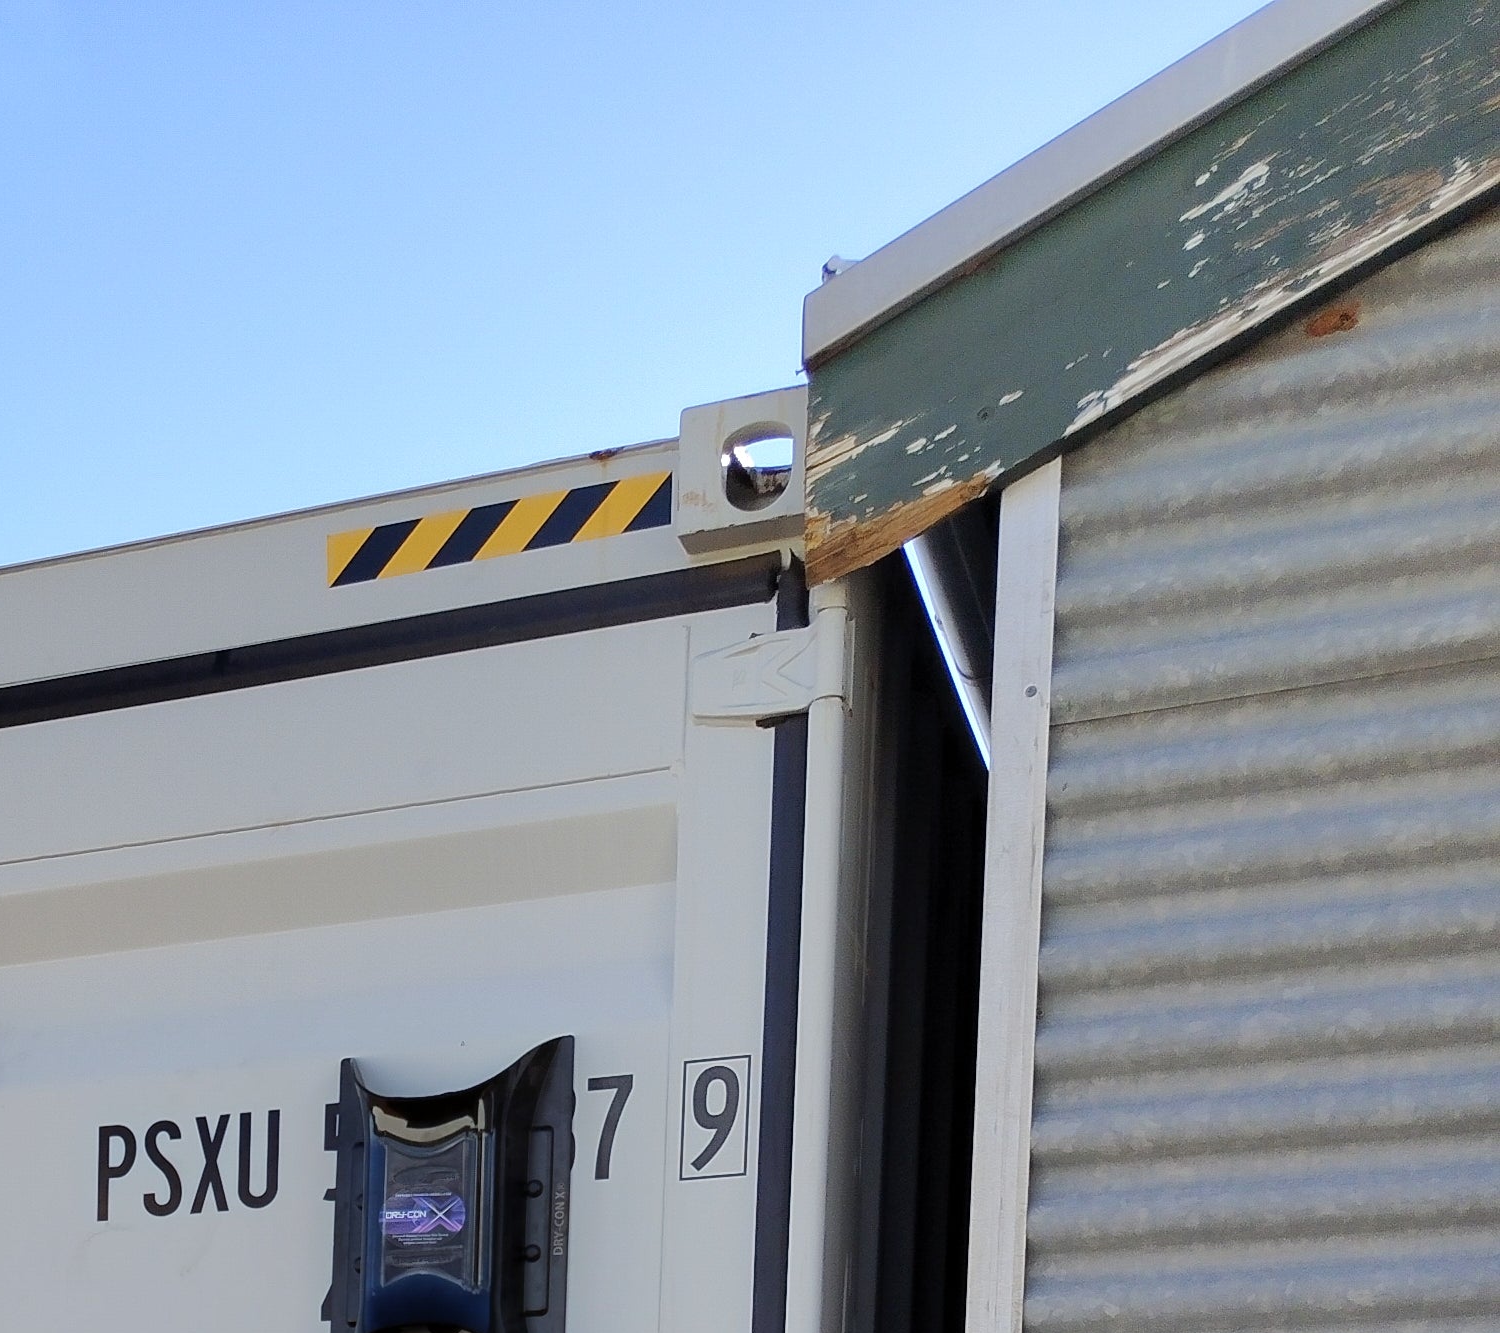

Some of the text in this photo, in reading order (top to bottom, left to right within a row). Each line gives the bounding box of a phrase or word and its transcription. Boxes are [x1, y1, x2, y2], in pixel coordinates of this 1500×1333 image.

[97, 1108, 281, 1222] PSXU
[690, 1065, 740, 1172] 9
[385, 1210, 427, 1220] DRY-CON
[553, 1201, 566, 1256] DRY-CON
